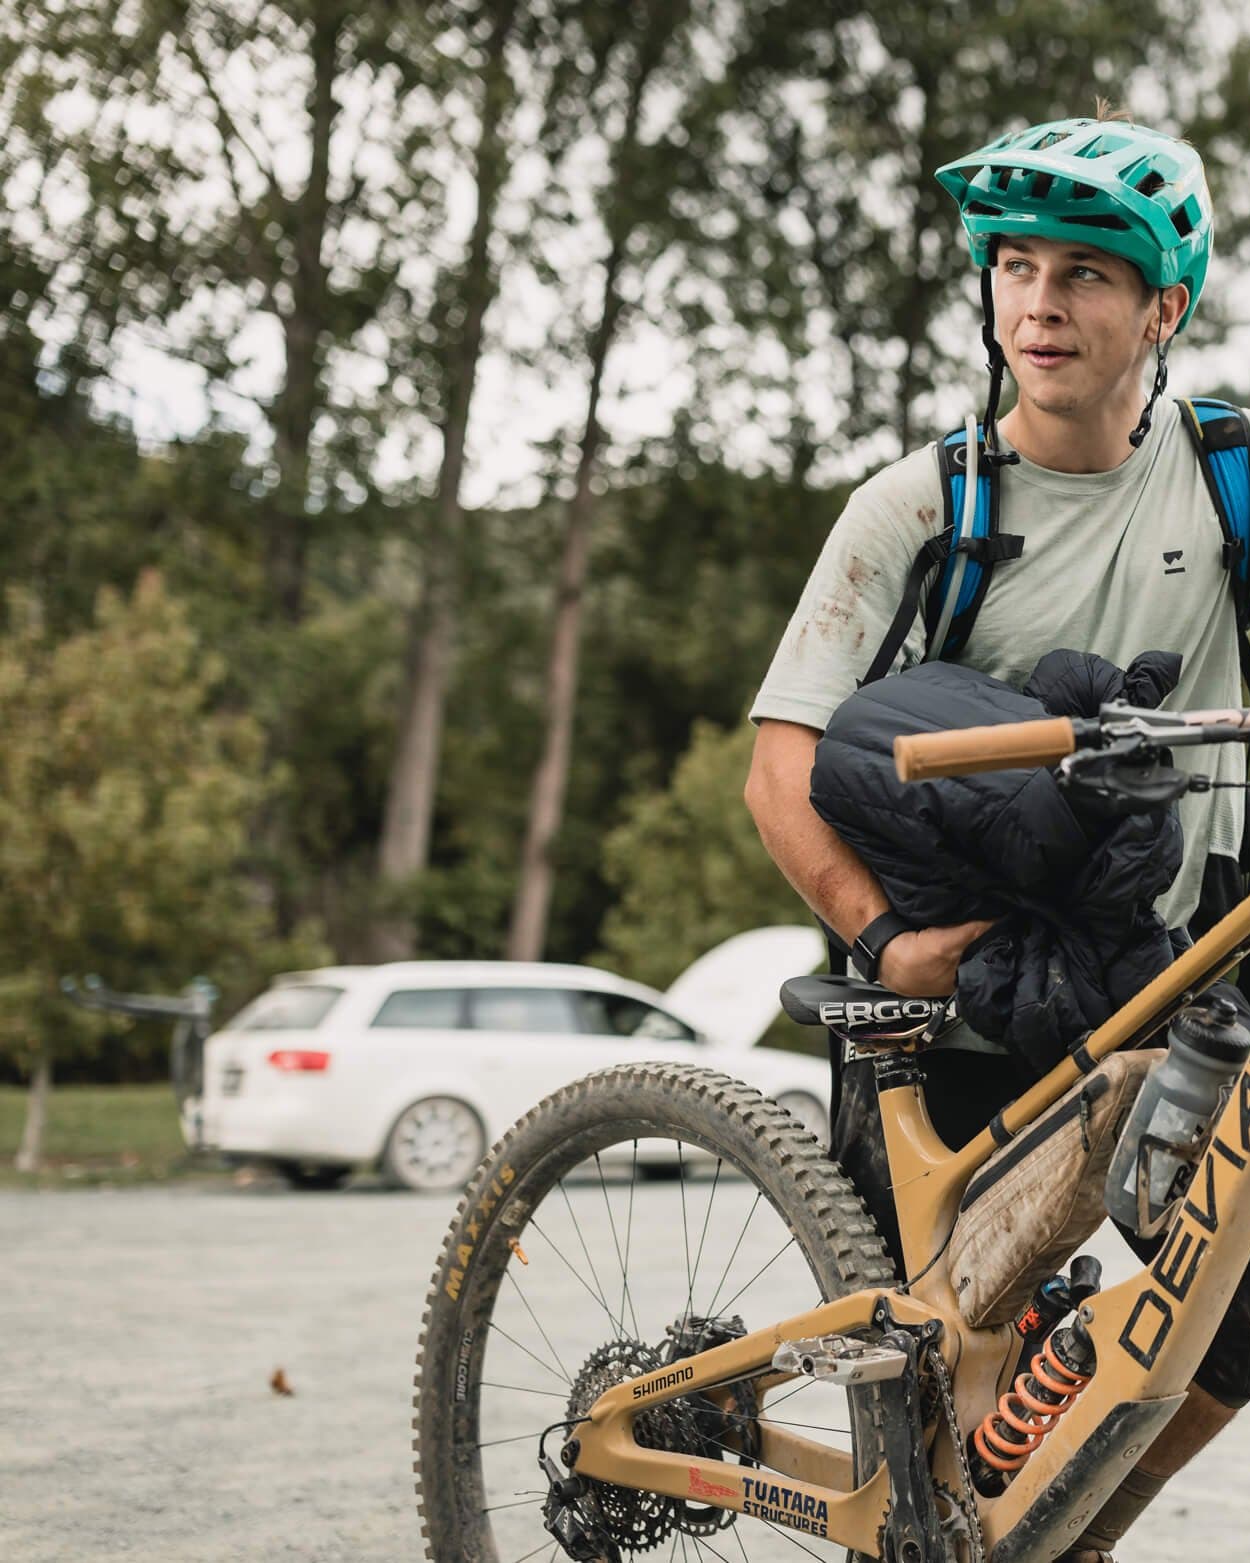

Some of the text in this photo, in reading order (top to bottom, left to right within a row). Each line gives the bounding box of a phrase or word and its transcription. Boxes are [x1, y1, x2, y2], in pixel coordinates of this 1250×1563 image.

[444, 1162, 515, 1301] MAXXIS
[633, 1366, 694, 1399] SHIMANO
[742, 1477, 828, 1523] TUATARA
[743, 1501, 828, 1538] STRUCTURES
